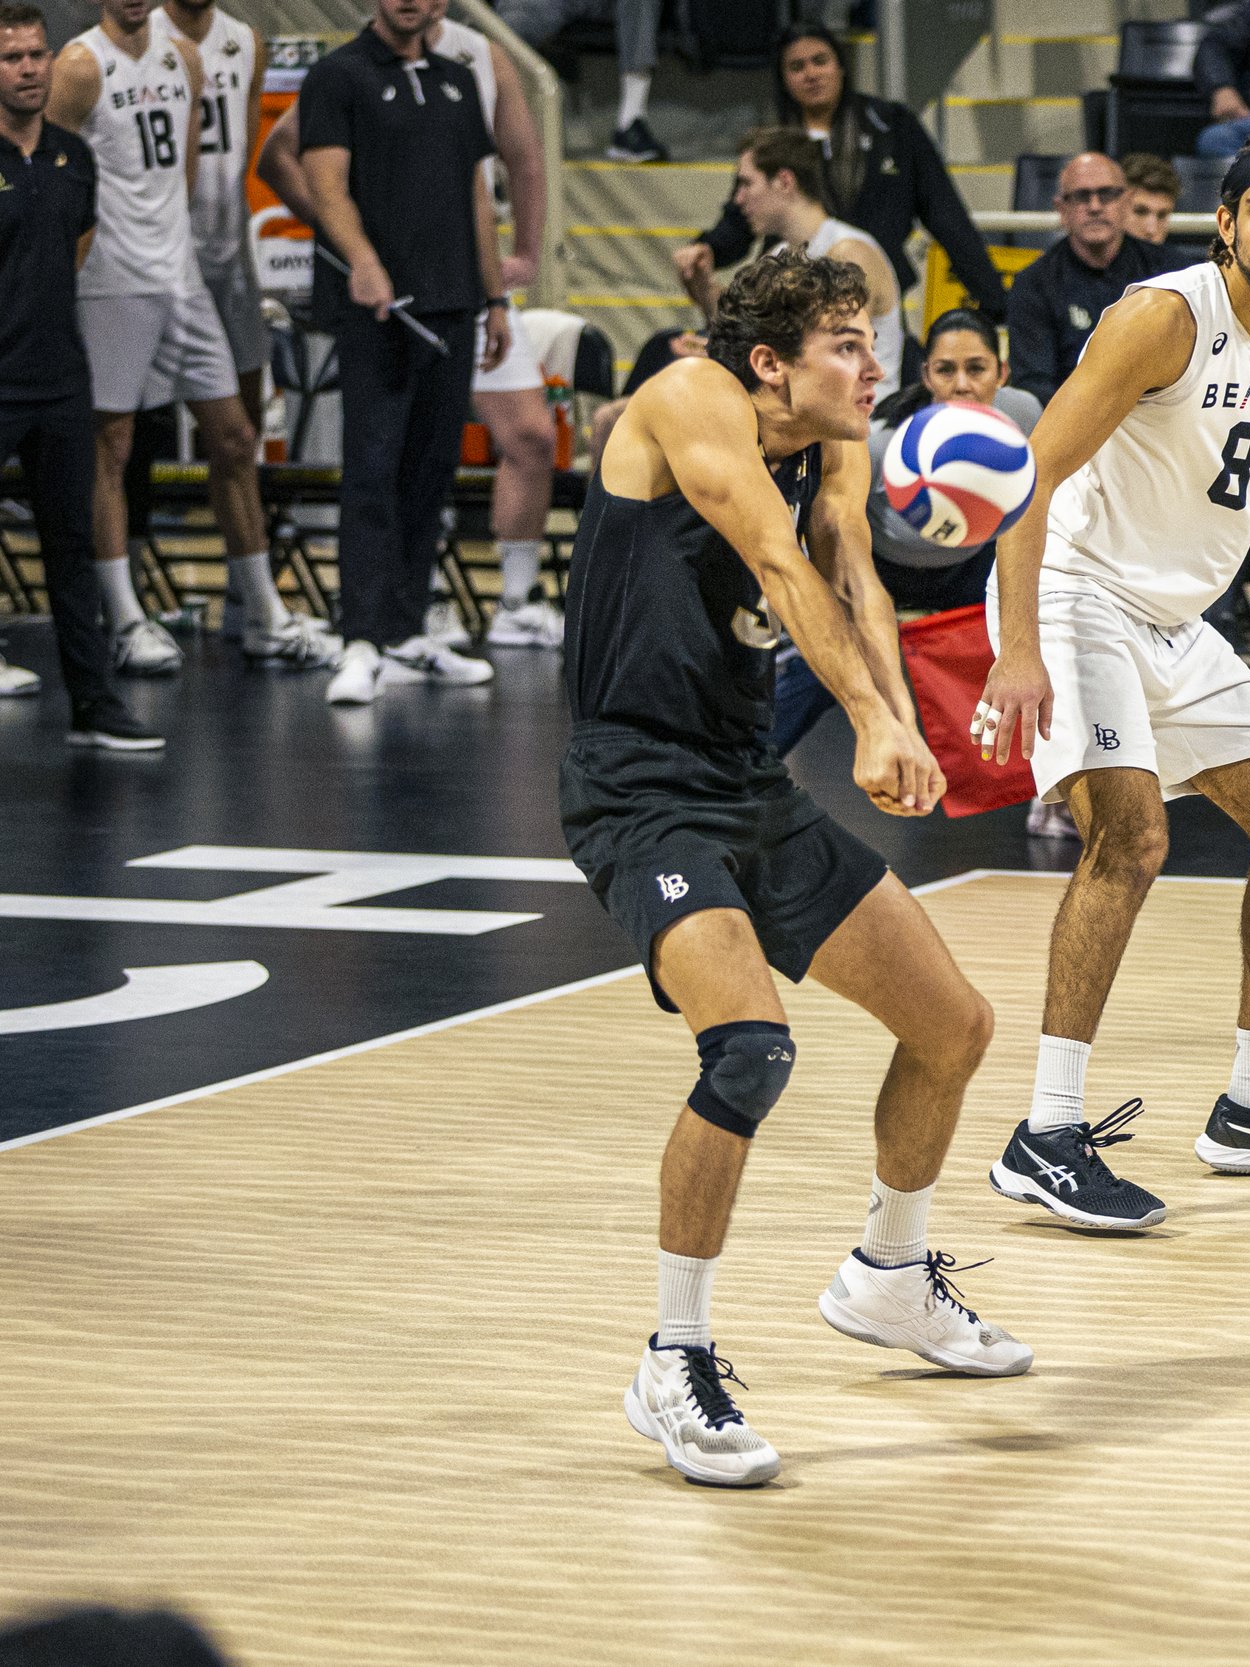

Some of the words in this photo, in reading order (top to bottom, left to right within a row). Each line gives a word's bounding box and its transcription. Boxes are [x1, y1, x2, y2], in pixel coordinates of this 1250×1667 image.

[111, 84, 187, 110] BEACH
[135, 109, 177, 169] 18
[1092, 722, 1121, 752] LB
